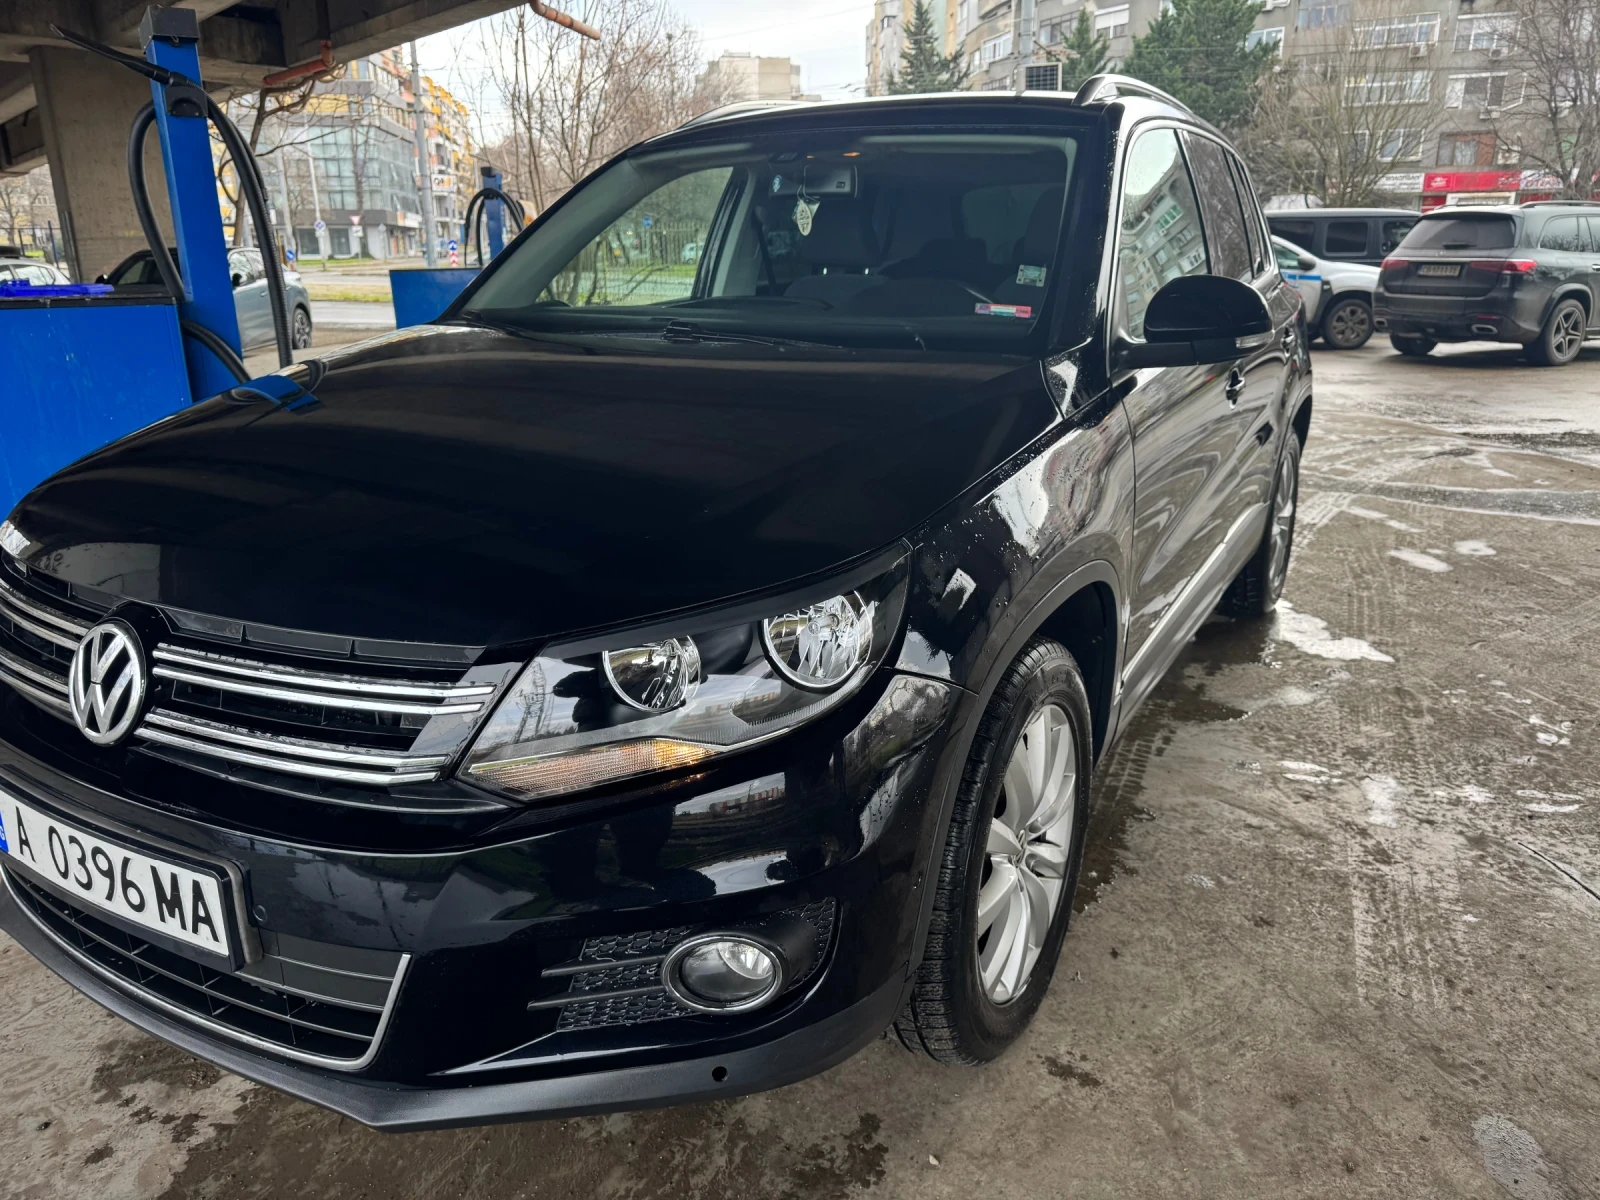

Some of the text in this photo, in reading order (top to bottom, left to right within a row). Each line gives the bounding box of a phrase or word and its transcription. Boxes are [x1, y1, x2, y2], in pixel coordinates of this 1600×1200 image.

[70, 623, 141, 744] VW
[15, 805, 220, 943] A 0396 MA
